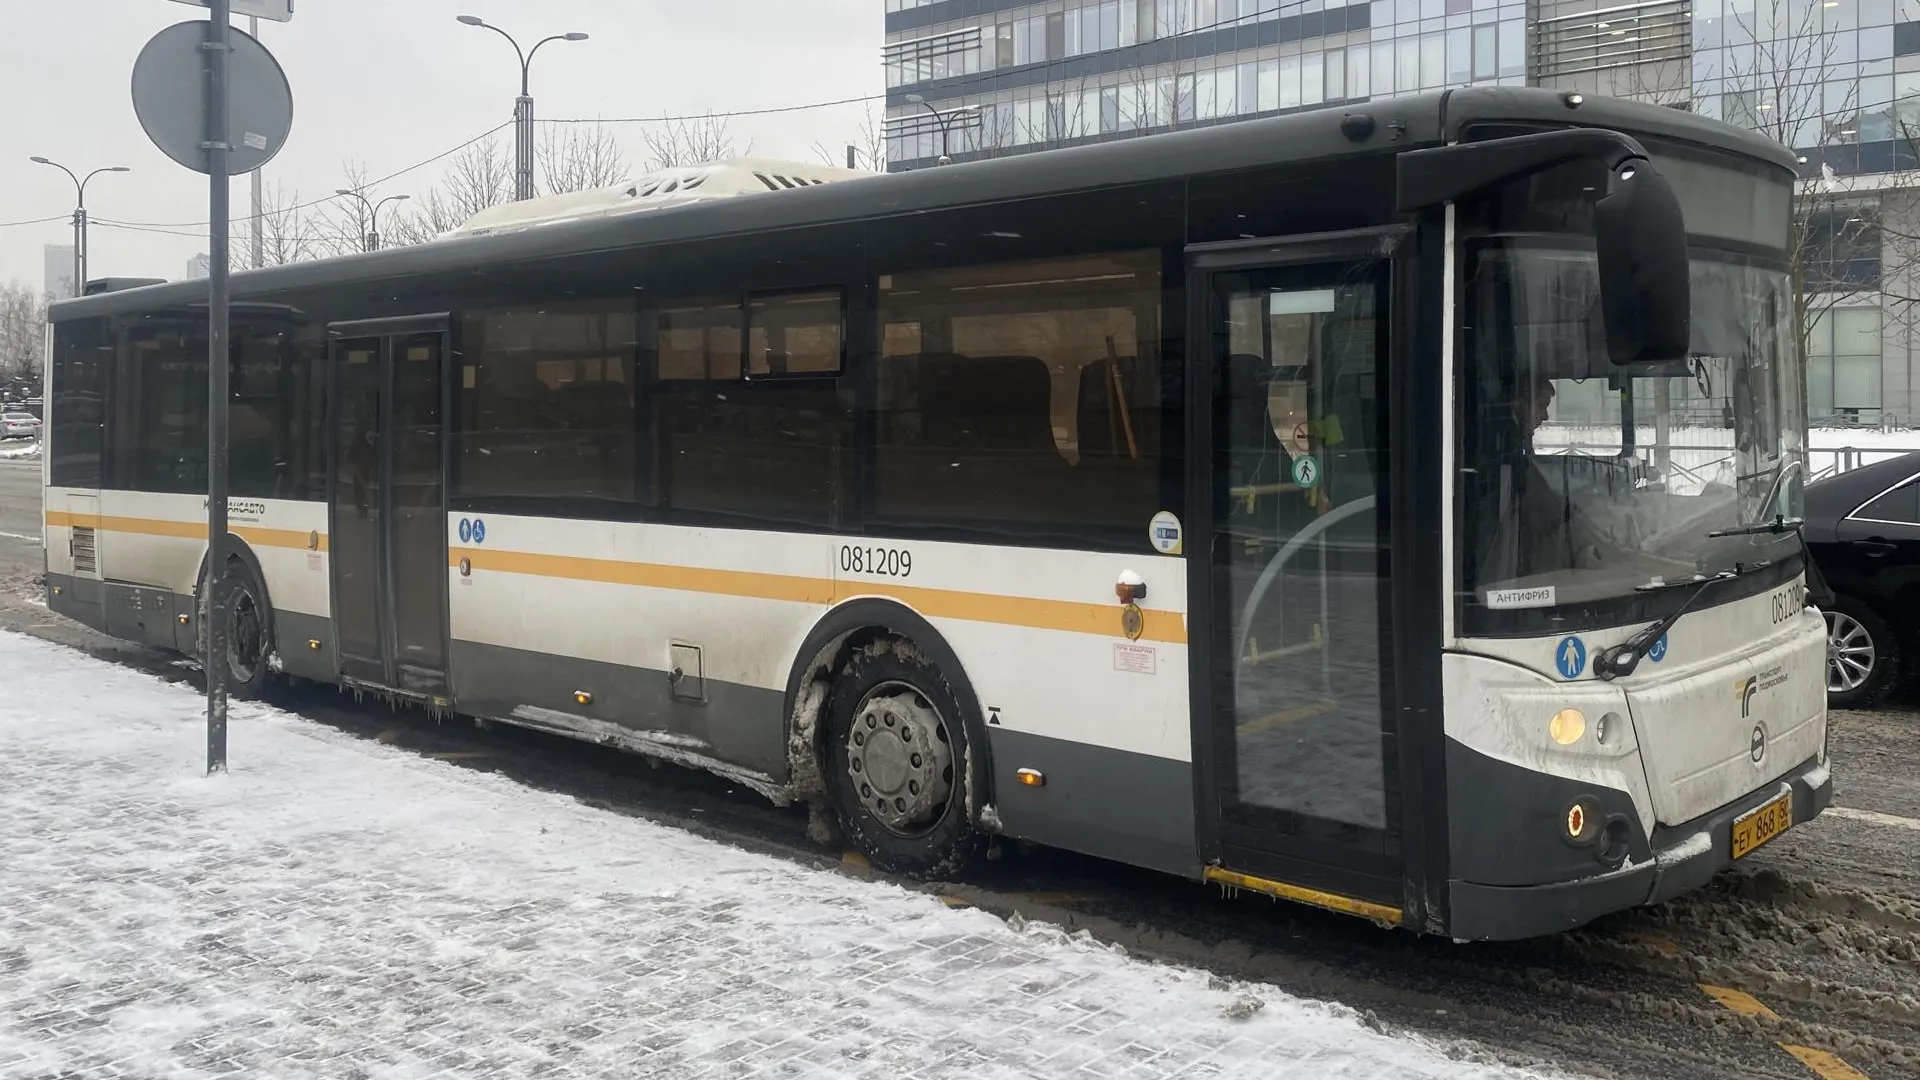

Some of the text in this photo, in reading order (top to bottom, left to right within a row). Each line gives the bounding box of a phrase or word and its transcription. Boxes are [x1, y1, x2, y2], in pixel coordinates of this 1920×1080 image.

[841, 545, 912, 577] 081209
[1496, 590, 1550, 603] АНТИФРИЗ
[1771, 583, 1801, 624] 081209
[1756, 809, 1775, 840] 868
